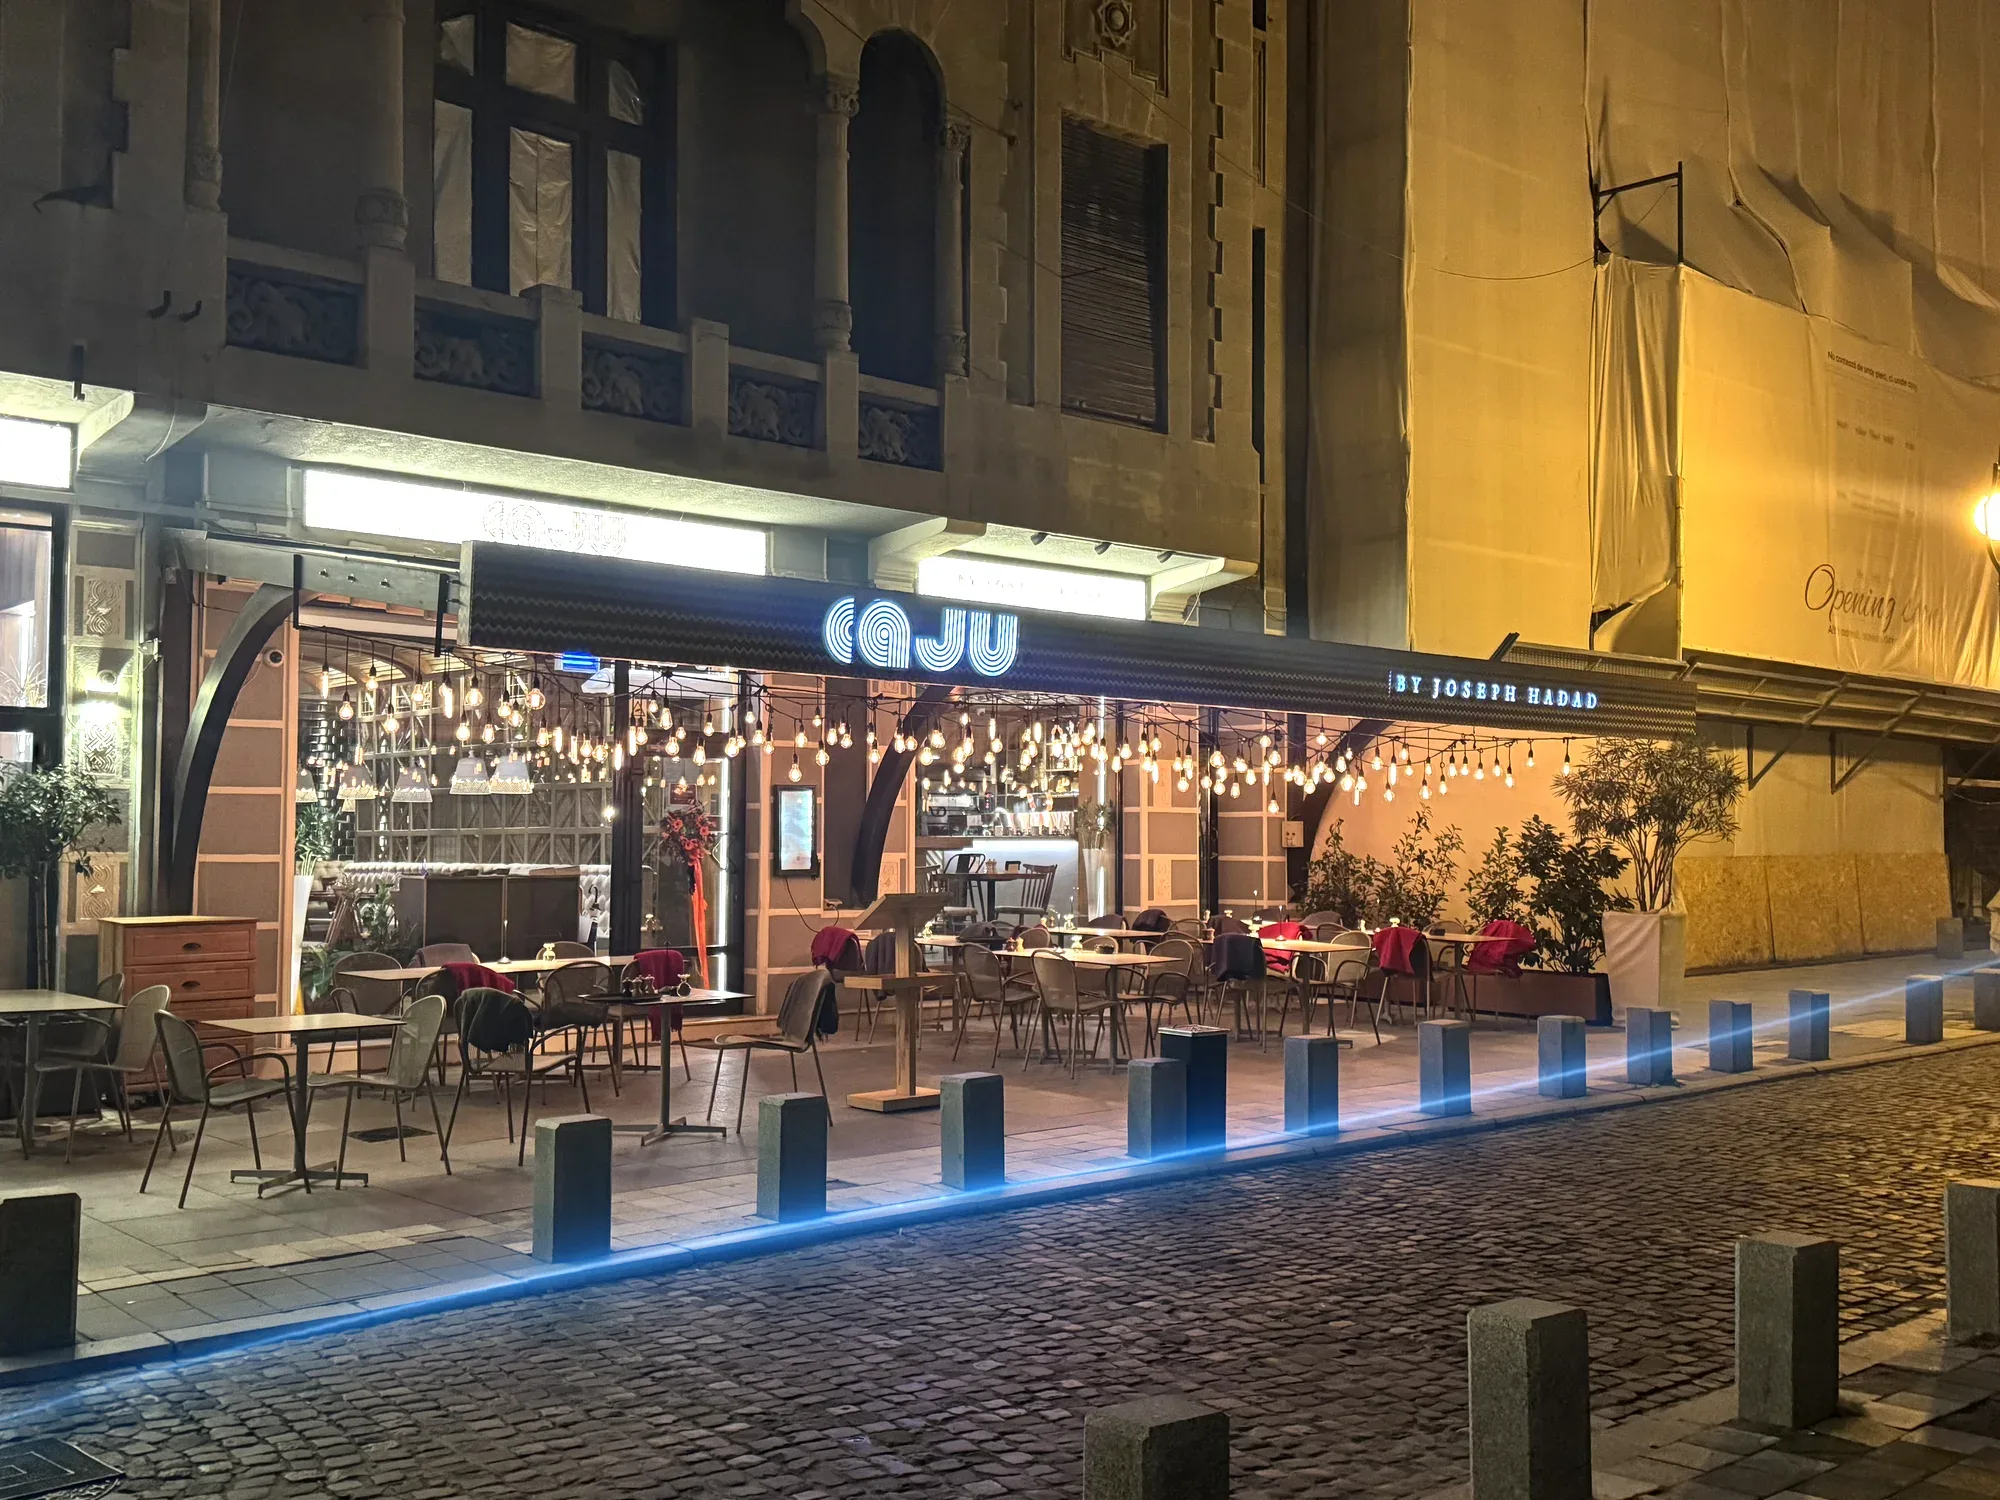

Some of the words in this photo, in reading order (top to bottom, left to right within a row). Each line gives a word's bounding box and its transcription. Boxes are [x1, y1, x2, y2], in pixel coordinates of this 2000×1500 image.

[1805, 564, 1897, 633] Opening
[1395, 674, 1422, 694] BY
[1432, 678, 1517, 703] JOSEPH
[1528, 687, 1598, 710] HADAD
